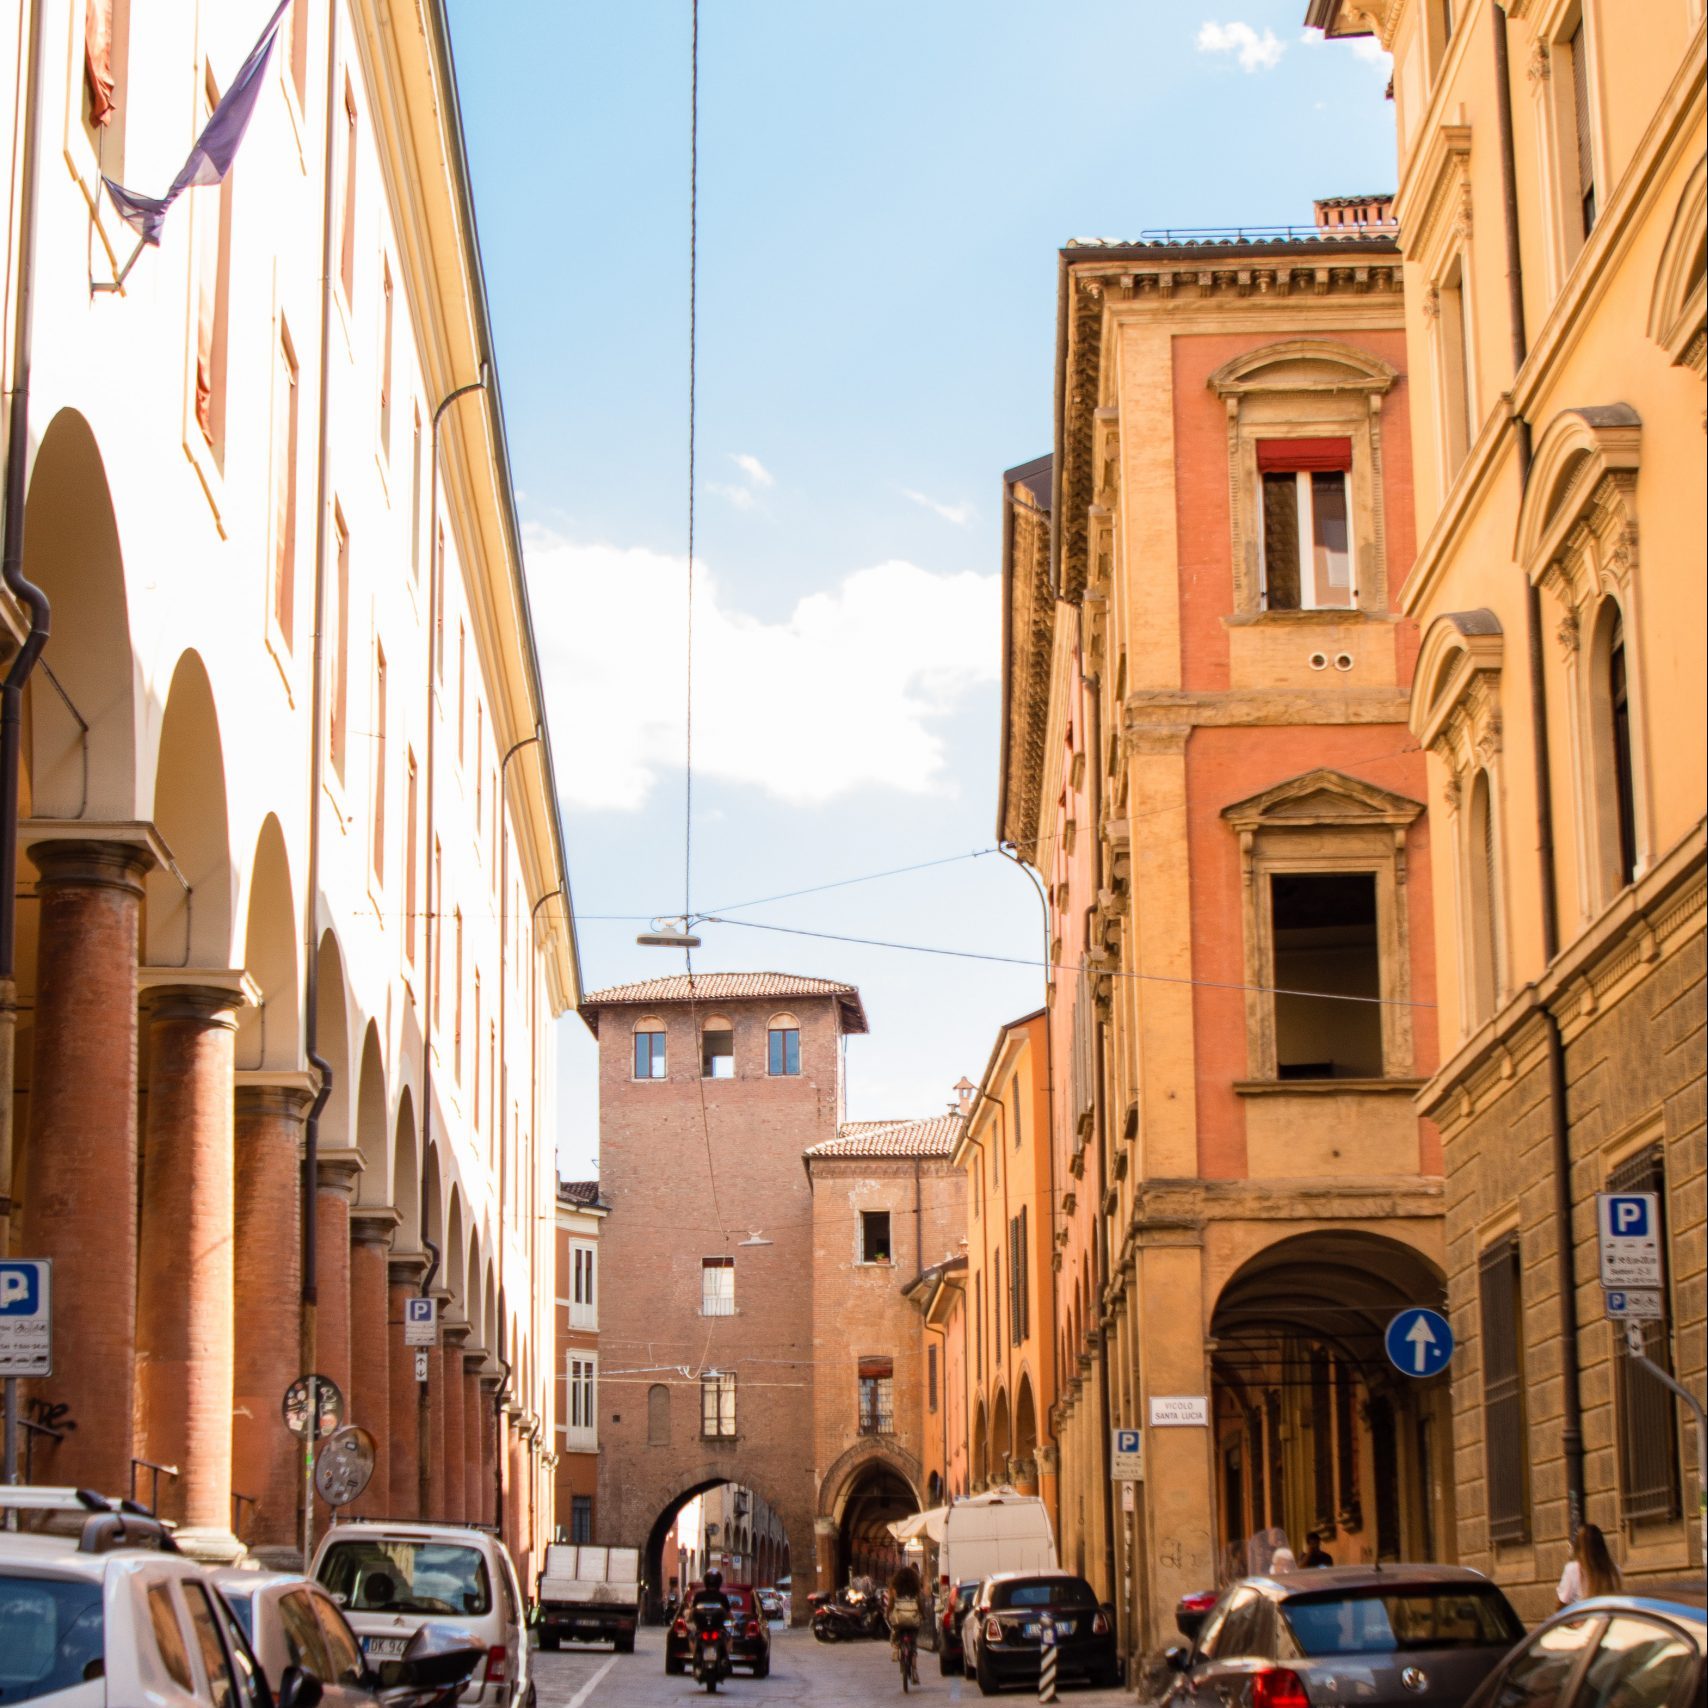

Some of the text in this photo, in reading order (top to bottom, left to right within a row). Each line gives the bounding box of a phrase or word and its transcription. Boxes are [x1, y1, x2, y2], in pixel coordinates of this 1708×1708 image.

[1617, 1203, 1641, 1232] P
[0, 1270, 29, 1308] P
[1612, 1295, 1622, 1309] P
[414, 1302, 428, 1320] P
[1164, 1401, 1193, 1410] VICOLO
[1155, 1411, 1203, 1420] SANTA LUCIA
[1122, 1433, 1136, 1450] P
